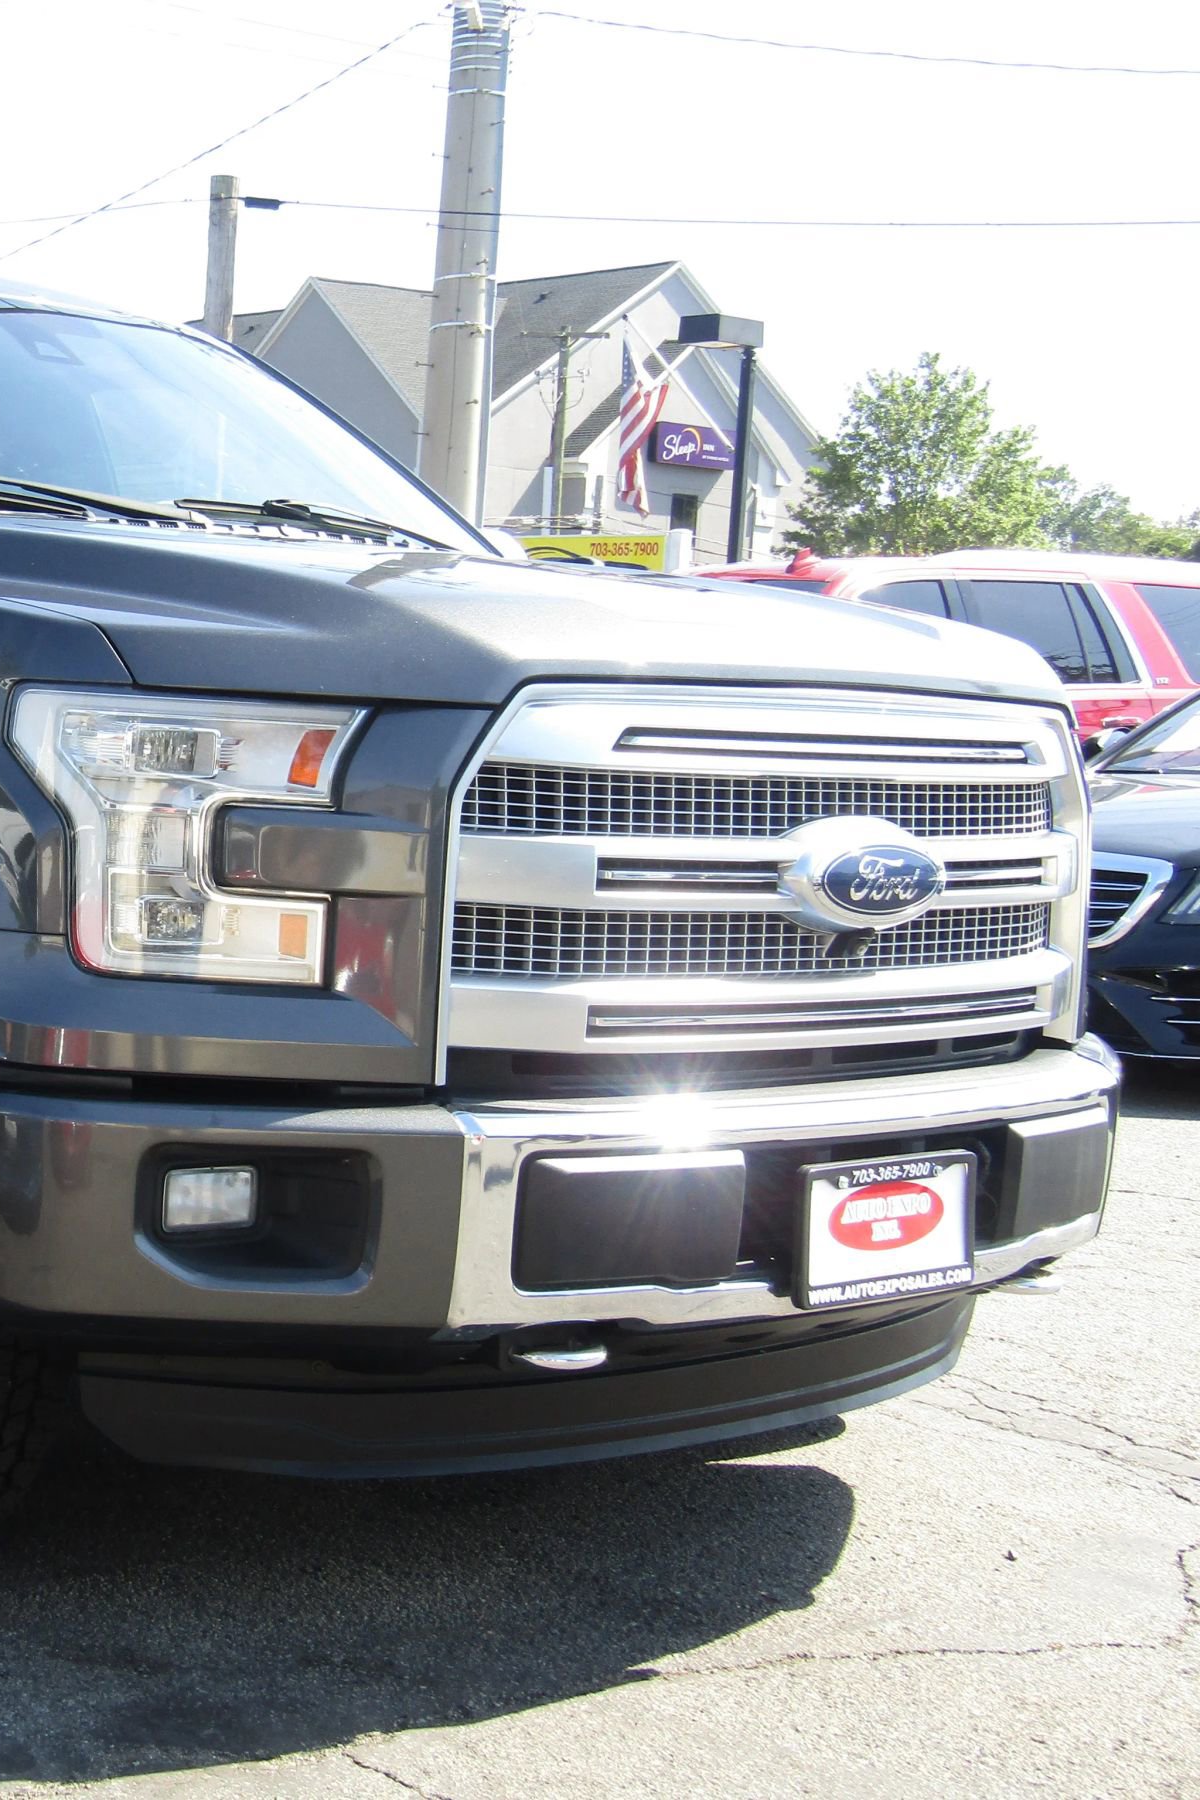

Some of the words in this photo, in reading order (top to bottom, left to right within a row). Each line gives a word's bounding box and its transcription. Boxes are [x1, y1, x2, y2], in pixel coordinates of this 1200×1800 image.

[663, 434, 697, 462] Sleep
[589, 541, 660, 557] 703-365-7900
[850, 854, 921, 901] Ford
[852, 1162, 930, 1184] 703-365-7900
[841, 1198, 886, 1224] AUTO
[808, 1268, 972, 1305] WWW.AUTOEXPOSALES.COM
